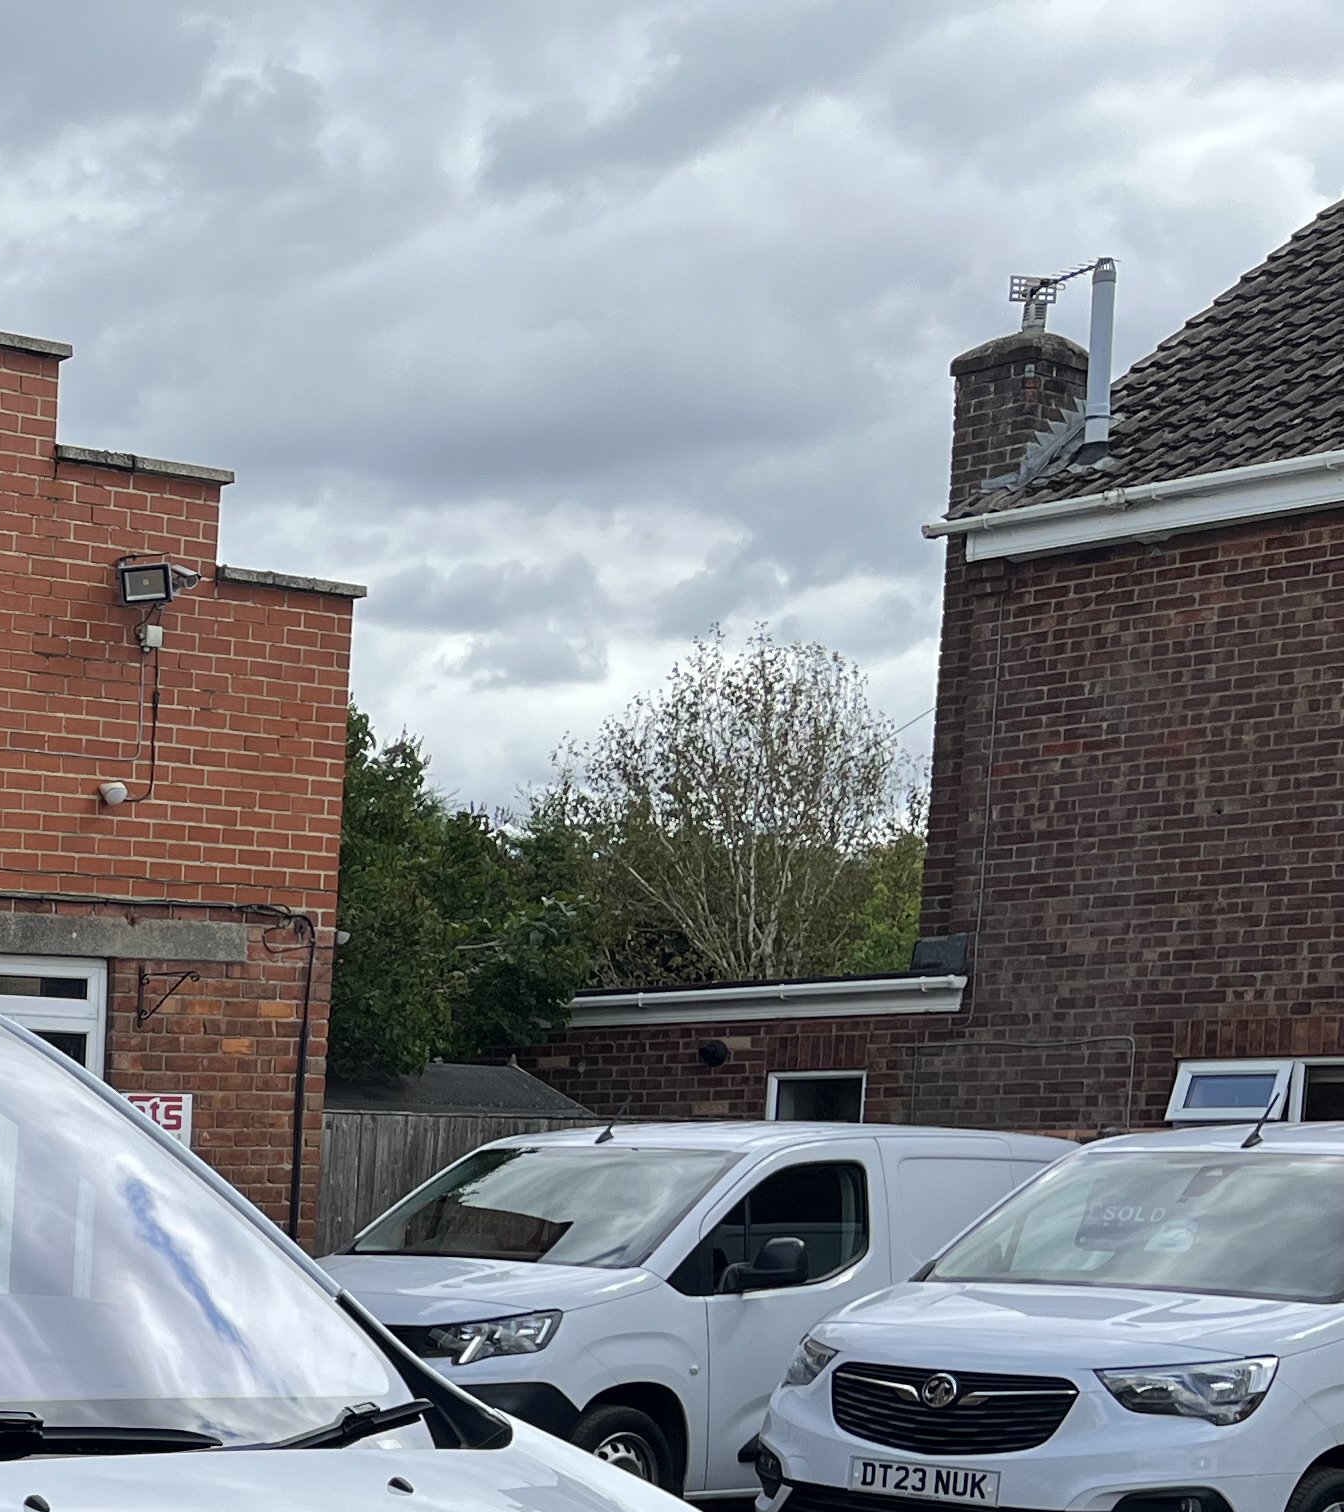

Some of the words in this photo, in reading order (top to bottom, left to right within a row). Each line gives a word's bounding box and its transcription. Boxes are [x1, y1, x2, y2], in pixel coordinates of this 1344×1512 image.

[1103, 1205, 1166, 1222] SOLD
[861, 1461, 927, 1492] DT23
[934, 1469, 987, 1499] NUK
